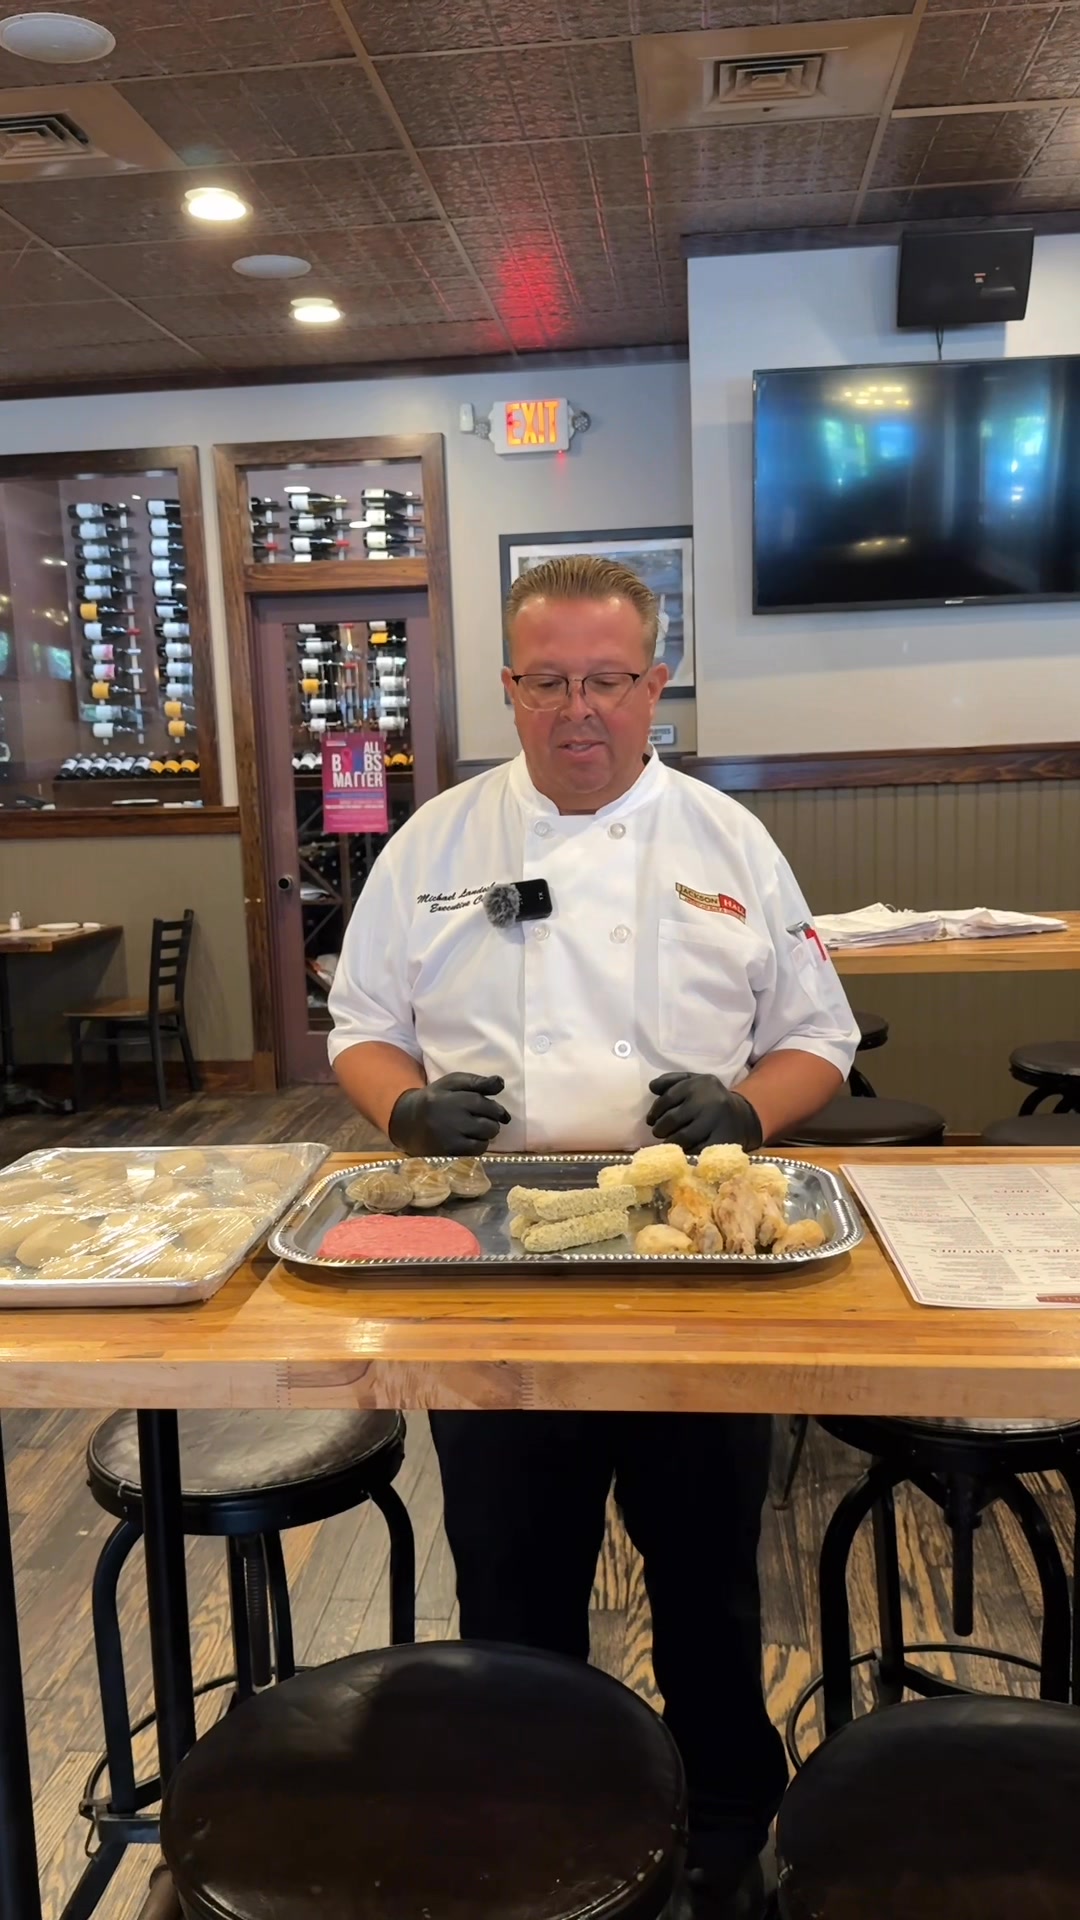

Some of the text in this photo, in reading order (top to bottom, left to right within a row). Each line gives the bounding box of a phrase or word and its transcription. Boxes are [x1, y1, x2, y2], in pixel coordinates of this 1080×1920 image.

[506, 400, 559, 445] EXIT
[363, 741, 381, 754] ALL
[332, 771, 383, 788] MATTER
[416, 891, 457, 904] Michael
[429, 900, 471, 913] Executive
